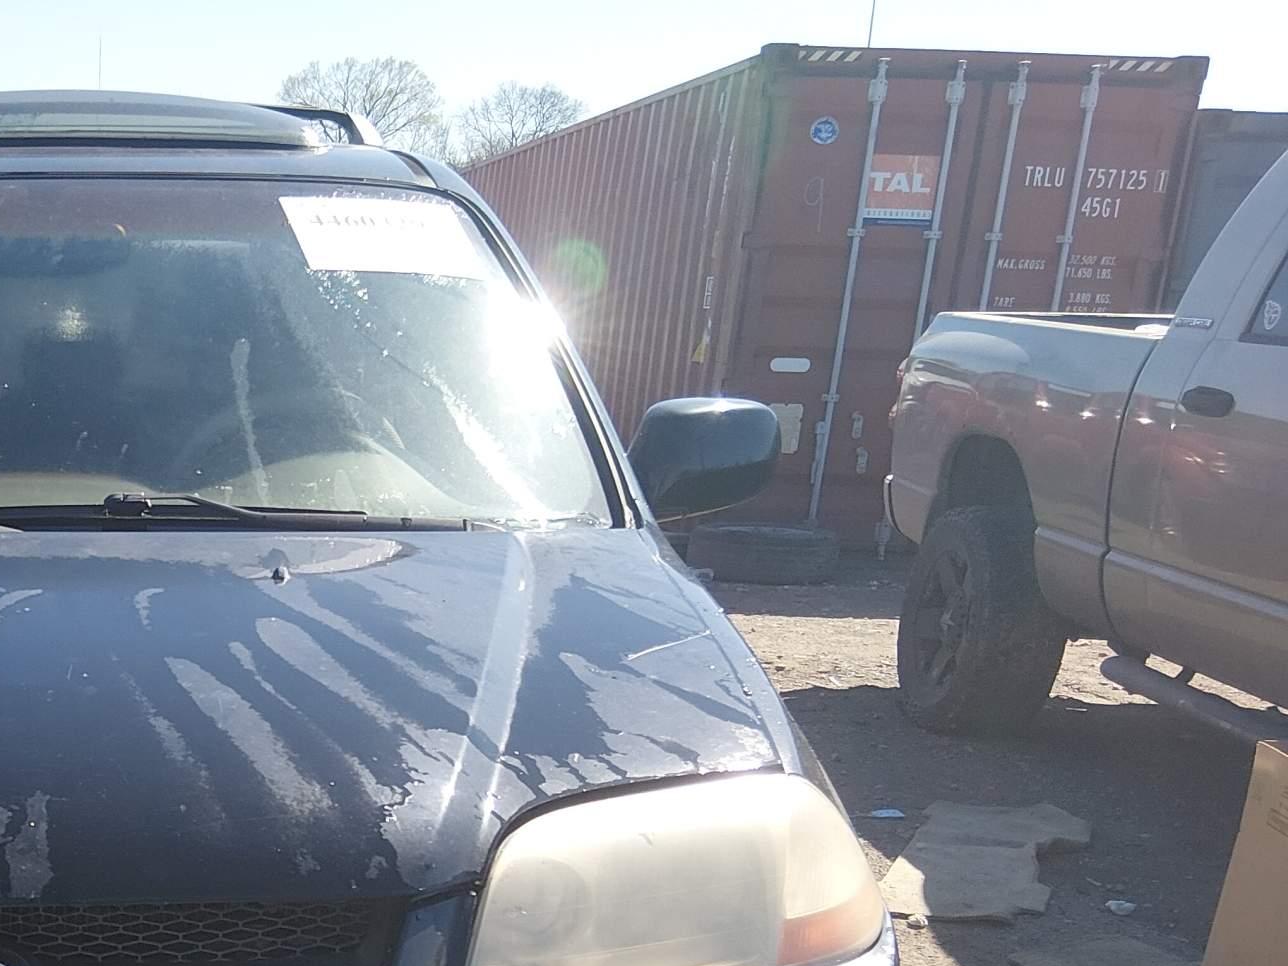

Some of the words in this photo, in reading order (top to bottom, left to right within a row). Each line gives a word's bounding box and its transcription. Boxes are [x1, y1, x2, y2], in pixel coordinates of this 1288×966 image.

[870, 171, 931, 193] TAL
[1024, 166, 1065, 187] TRLU
[1087, 168, 1148, 190] 757125
[1081, 197, 1121, 218] 45G1
